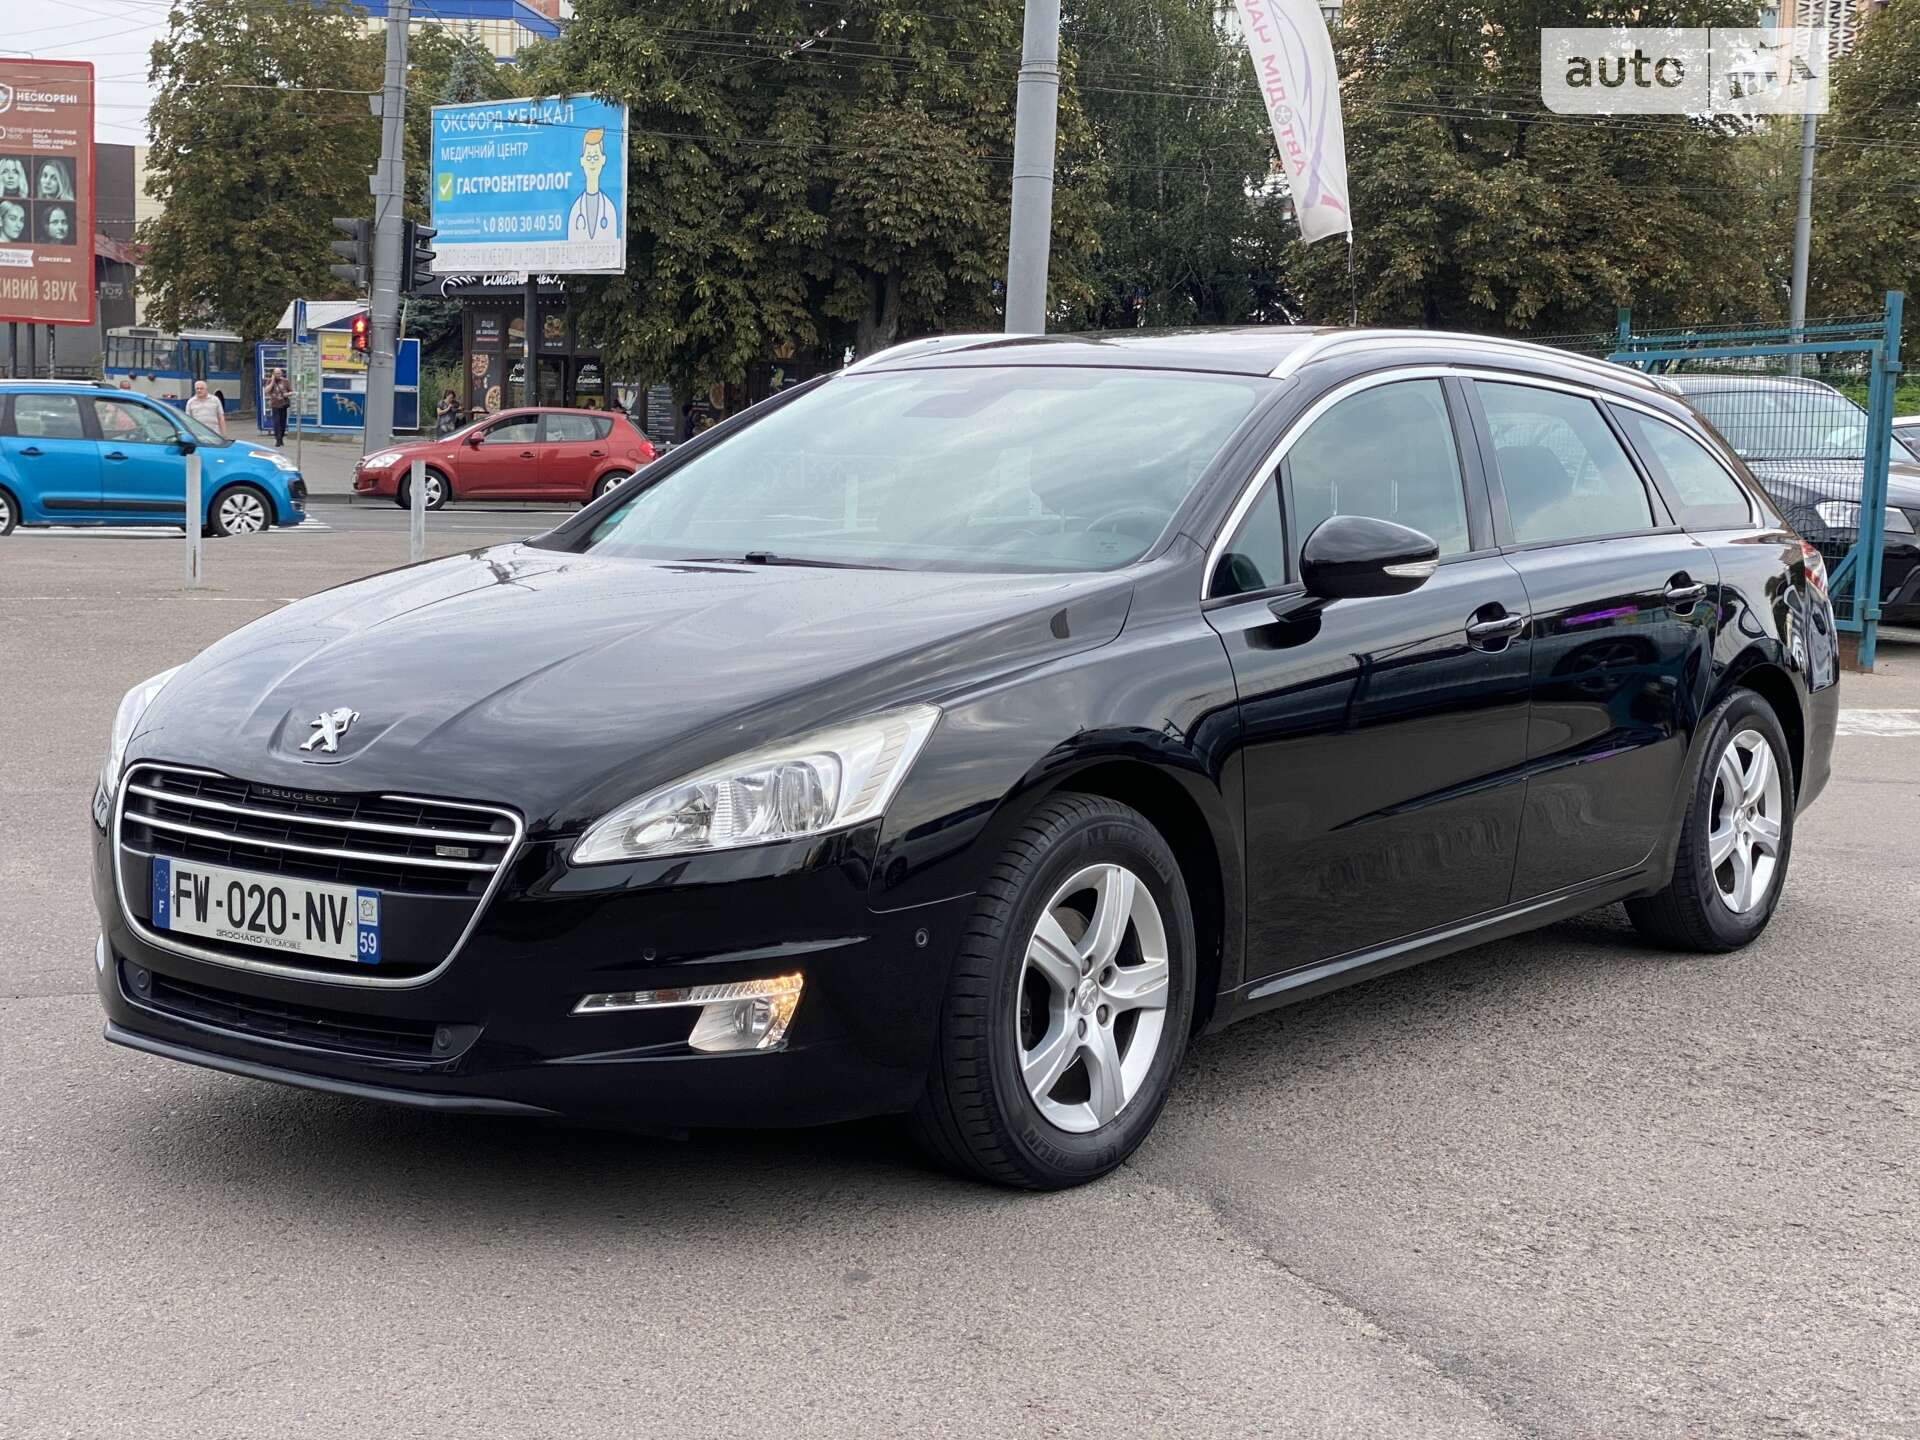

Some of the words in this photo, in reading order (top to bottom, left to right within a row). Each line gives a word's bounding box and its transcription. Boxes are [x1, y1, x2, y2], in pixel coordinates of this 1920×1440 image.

[16, 91, 78, 104] НЕСКОРЕНІ
[441, 141, 495, 163] МЕДИЧНИЙ
[497, 142, 529, 160] ЦЕНТР
[456, 172, 573, 195] ГАСТРОЕНТЕРОЛОГ
[498, 216, 518, 233] 800
[519, 216, 533, 233] 30
[533, 215, 545, 232] 40
[548, 214, 562, 231] 50
[42, 279, 78, 302] ЗВУК
[261, 787, 339, 804] PEUGEOT
[158, 900, 165, 914] F
[175, 870, 348, 945] FW-020-NV
[359, 931, 377, 954] 59
